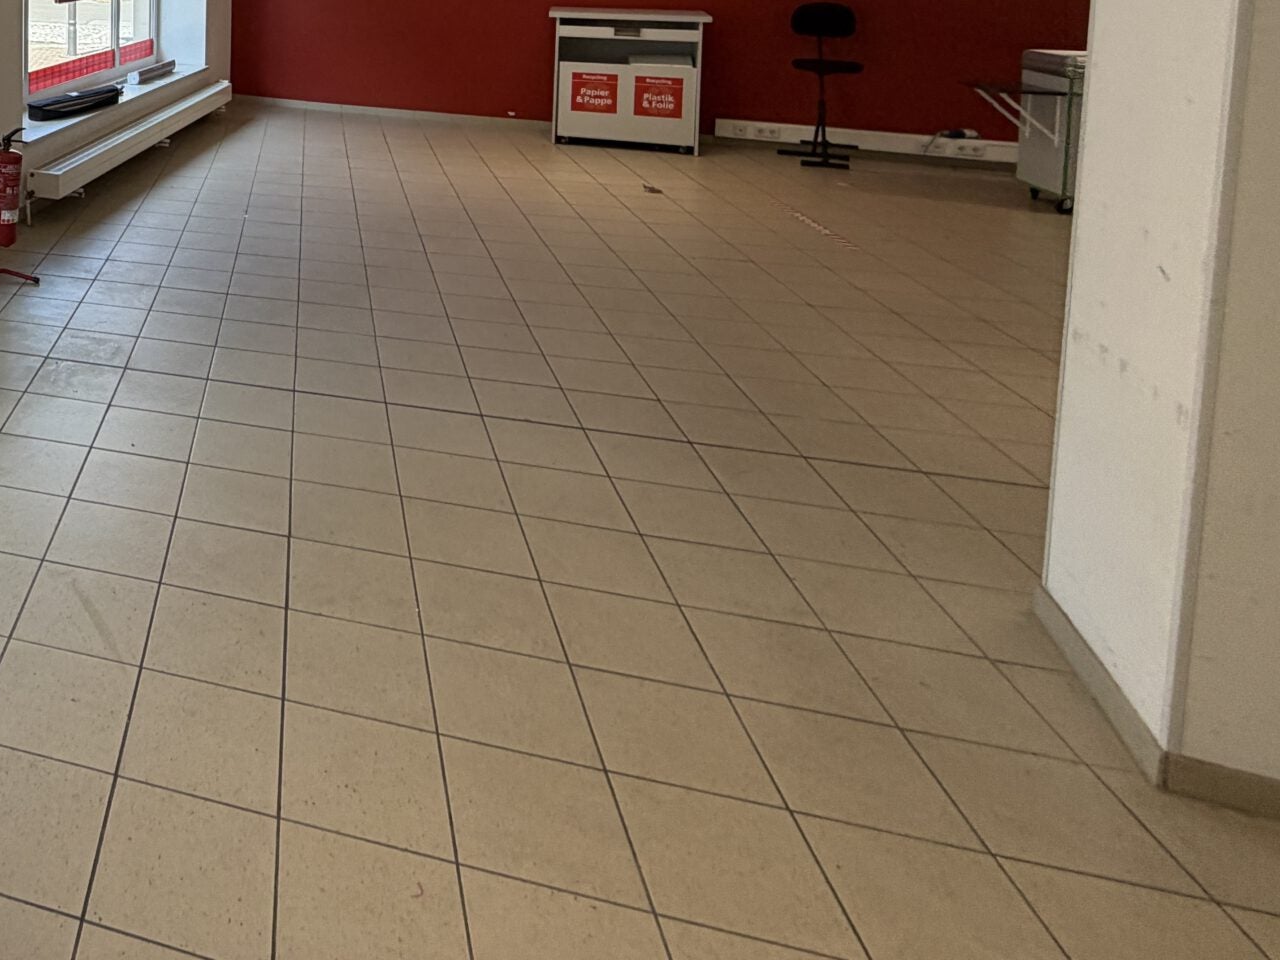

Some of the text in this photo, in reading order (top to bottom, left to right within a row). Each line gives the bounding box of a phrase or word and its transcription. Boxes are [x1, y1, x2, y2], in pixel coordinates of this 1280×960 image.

[580, 87, 610, 96] Papier
[576, 95, 612, 106] & Pappe
[644, 93, 674, 102] Plastik
[642, 100, 674, 109] & Folie
